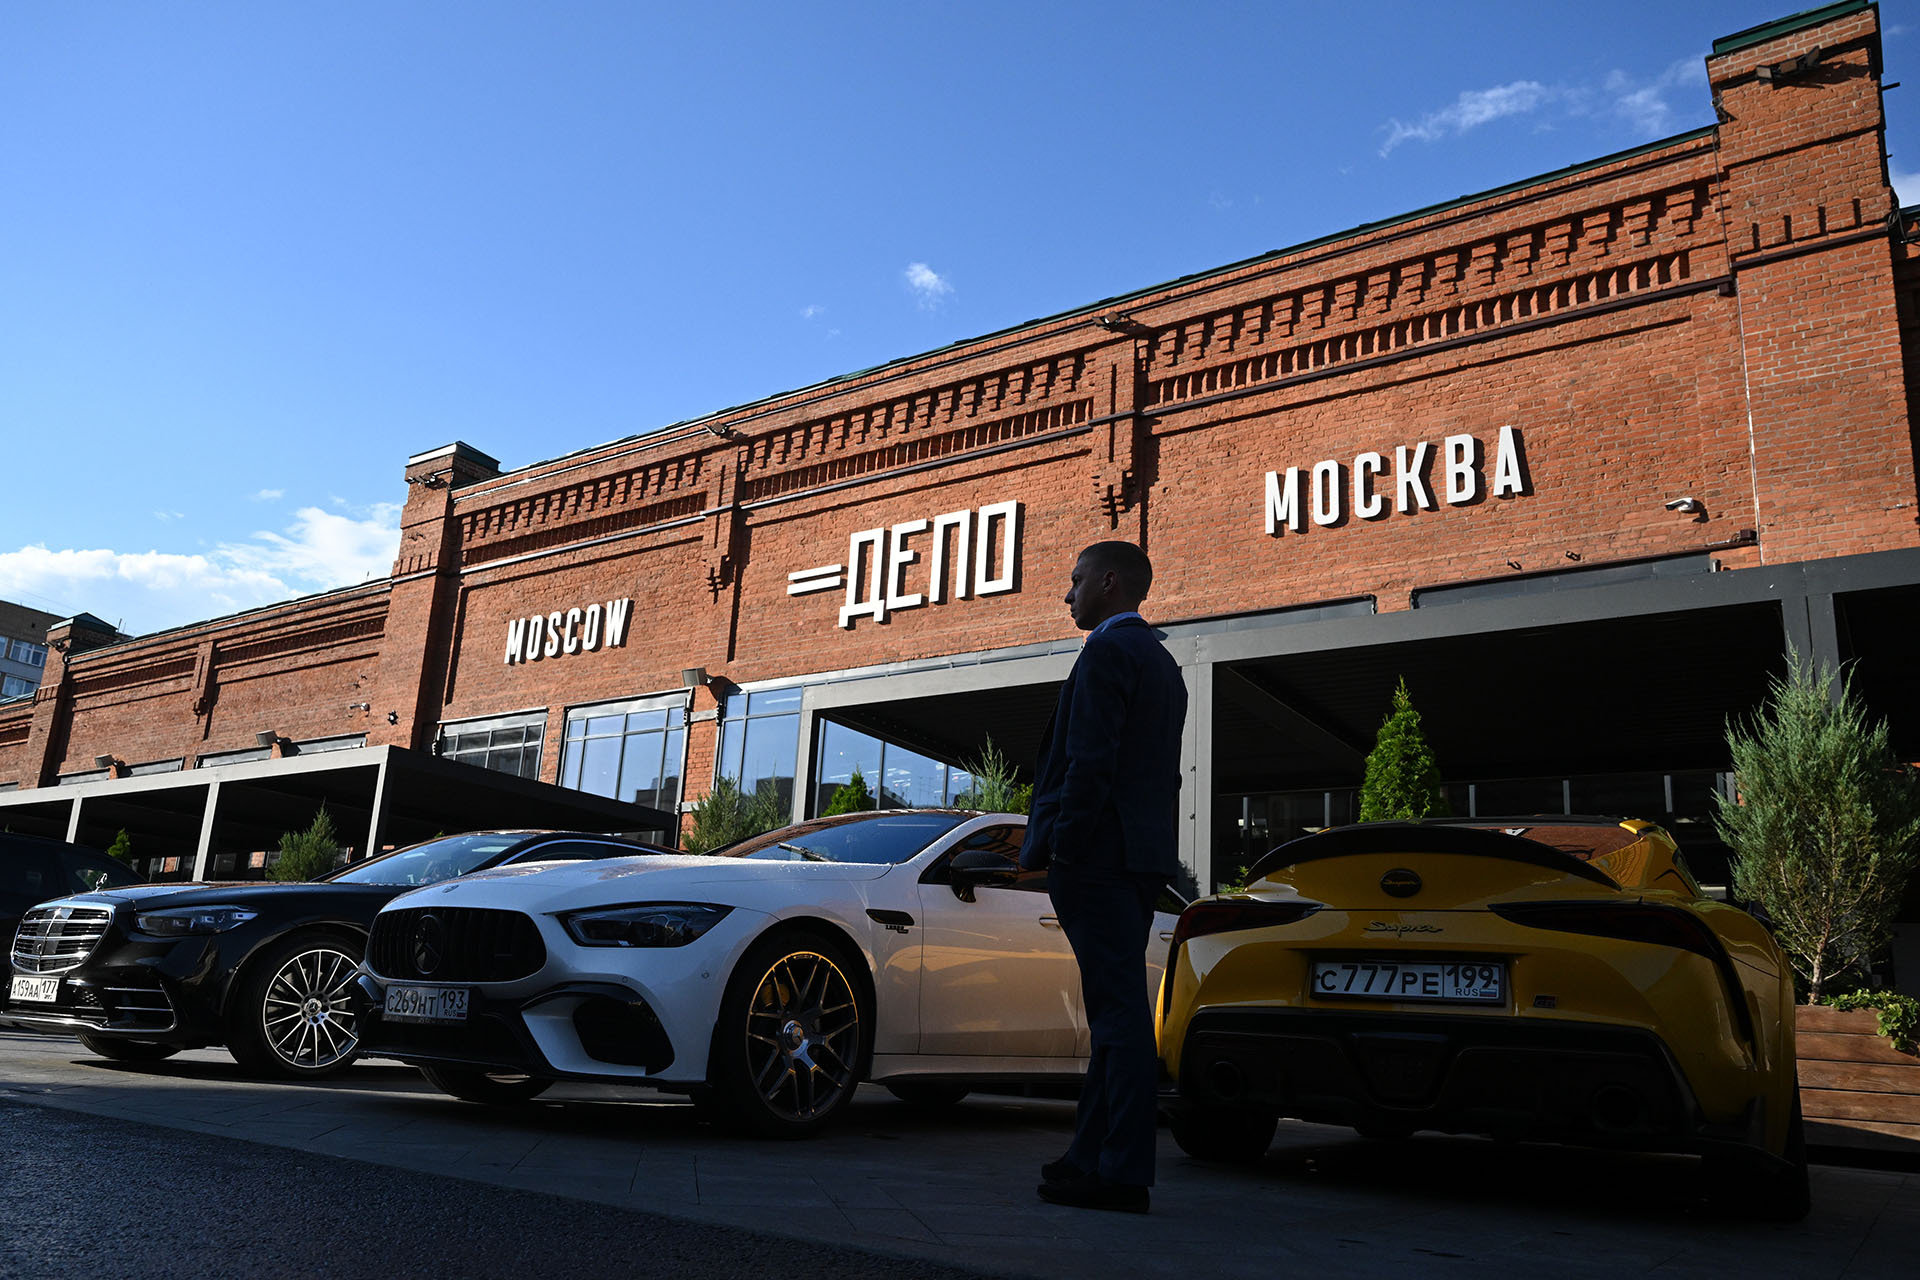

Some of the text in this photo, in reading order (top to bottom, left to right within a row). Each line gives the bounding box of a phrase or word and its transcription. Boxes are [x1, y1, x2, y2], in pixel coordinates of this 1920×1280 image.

[1265, 425, 1523, 534] МОСКВА
[838, 500, 1017, 628] ДЕПО
[504, 598, 628, 664] MOSCOW
[1363, 920, 1444, 938] Supra
[41, 980, 57, 994] 177
[1320, 964, 1494, 995] С777РЕ 199
[440, 990, 465, 1009] 193
[1455, 988, 1479, 997] RUS
[443, 1008, 457, 1017] RUS
